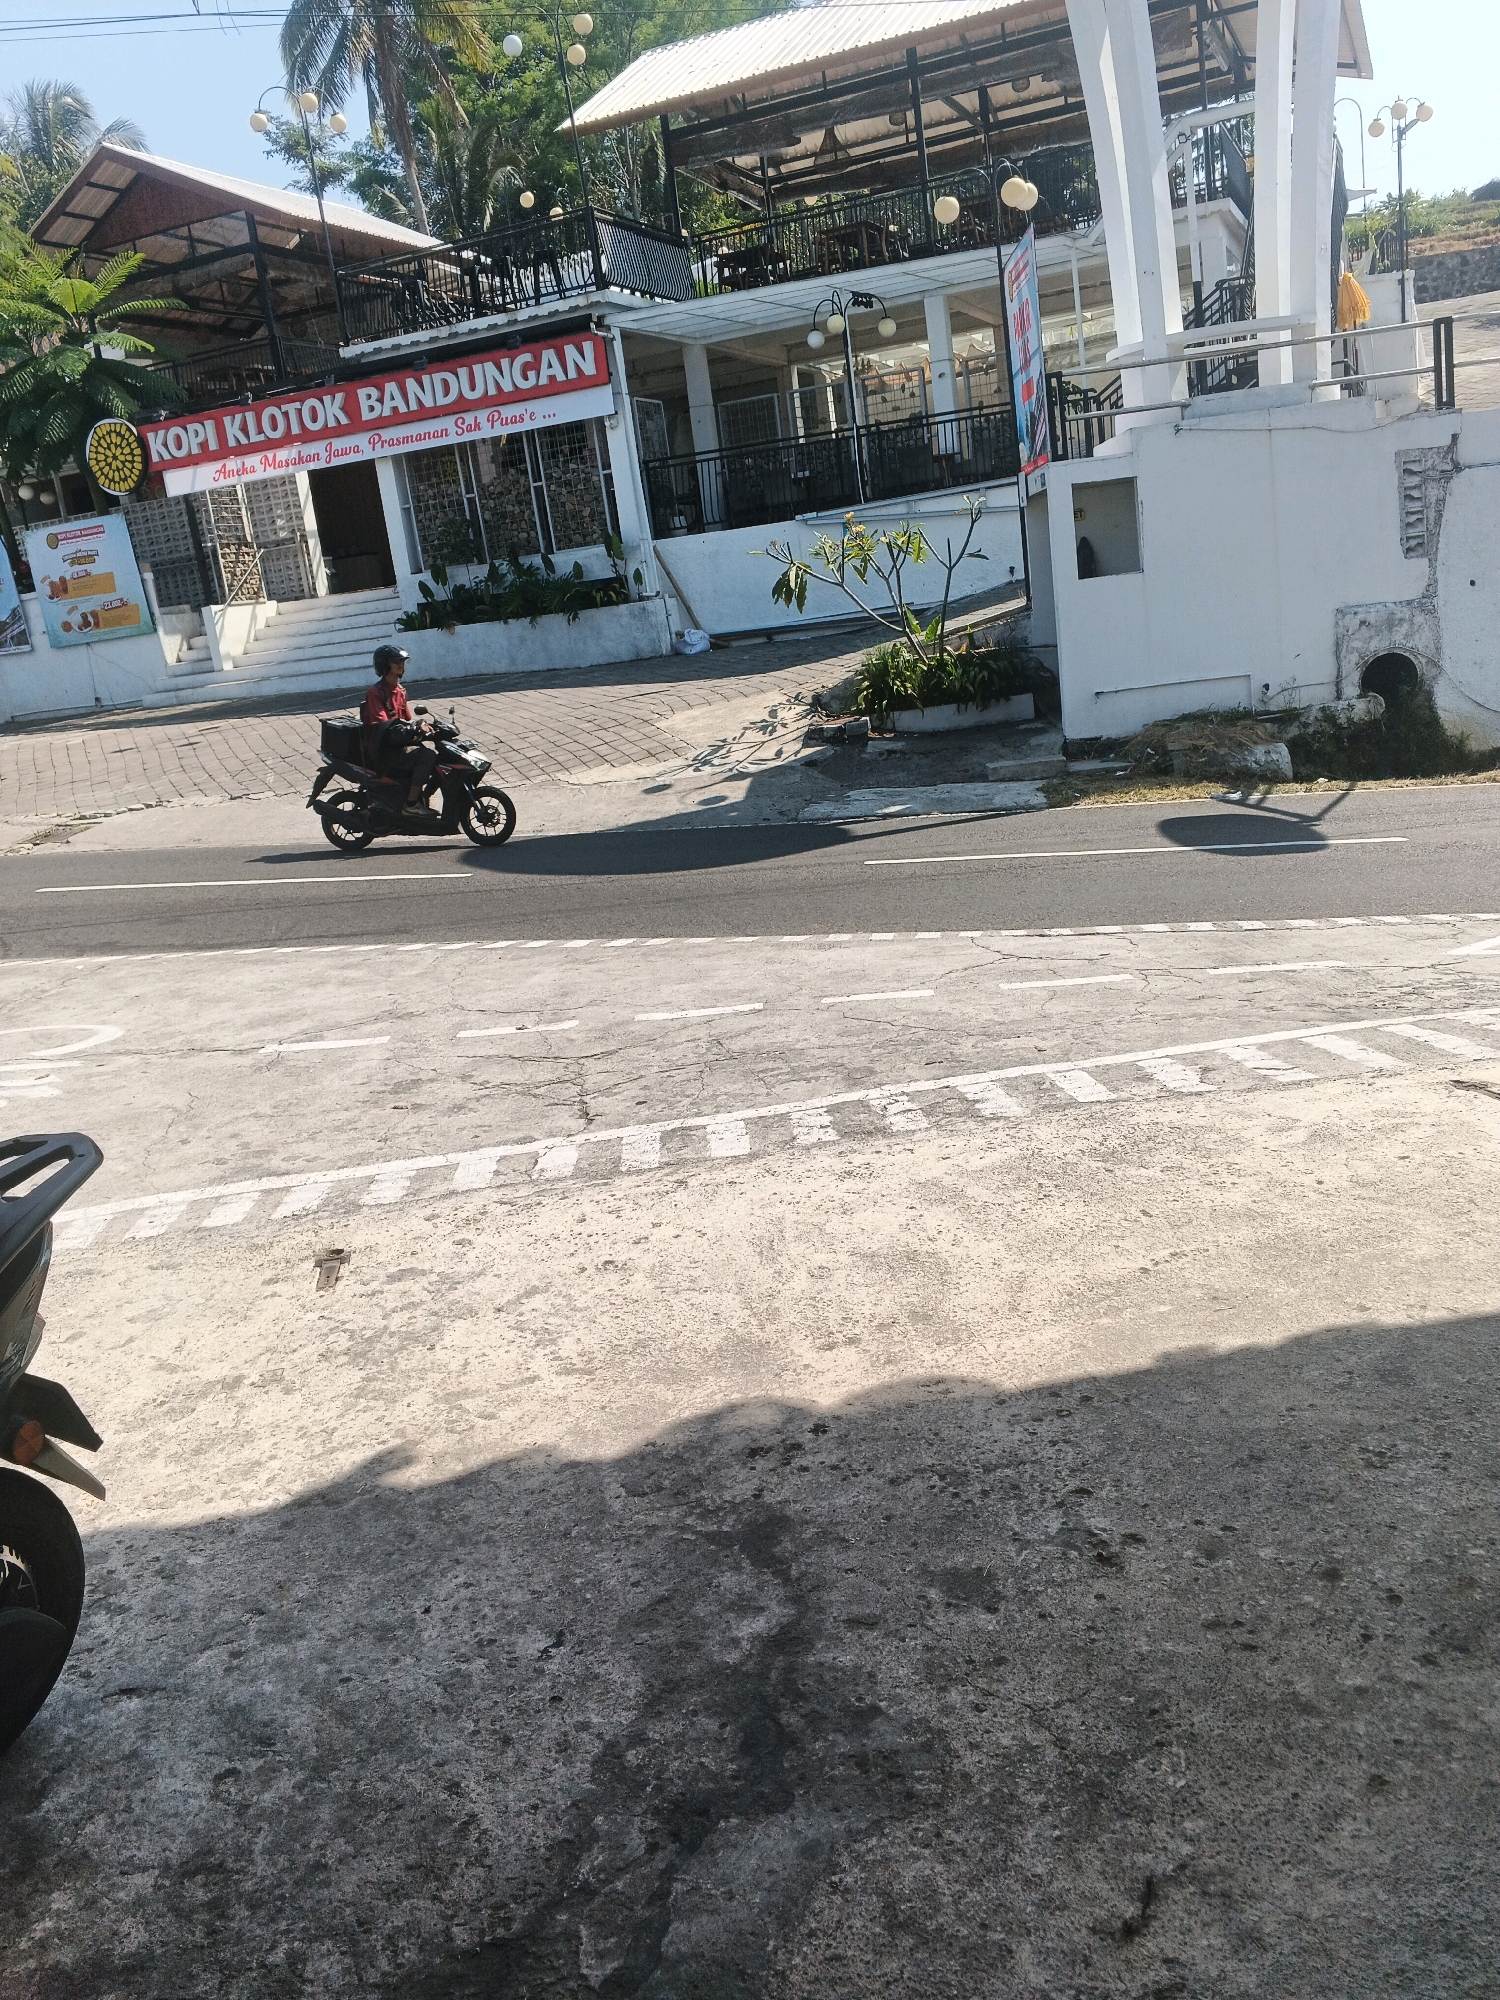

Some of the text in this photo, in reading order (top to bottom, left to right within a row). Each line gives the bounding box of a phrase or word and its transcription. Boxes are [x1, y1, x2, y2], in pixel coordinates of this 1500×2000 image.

[147, 340, 597, 463] KOPI KLOTOK BANDUNGAN
[212, 463, 257, 483] Aneka
[259, 452, 322, 471] Masakan
[324, 441, 365, 465] Jawa,
[368, 427, 450, 452] Prasmanan
[454, 415, 483, 437] Sak
[486, 408, 536, 430] Puas'e
